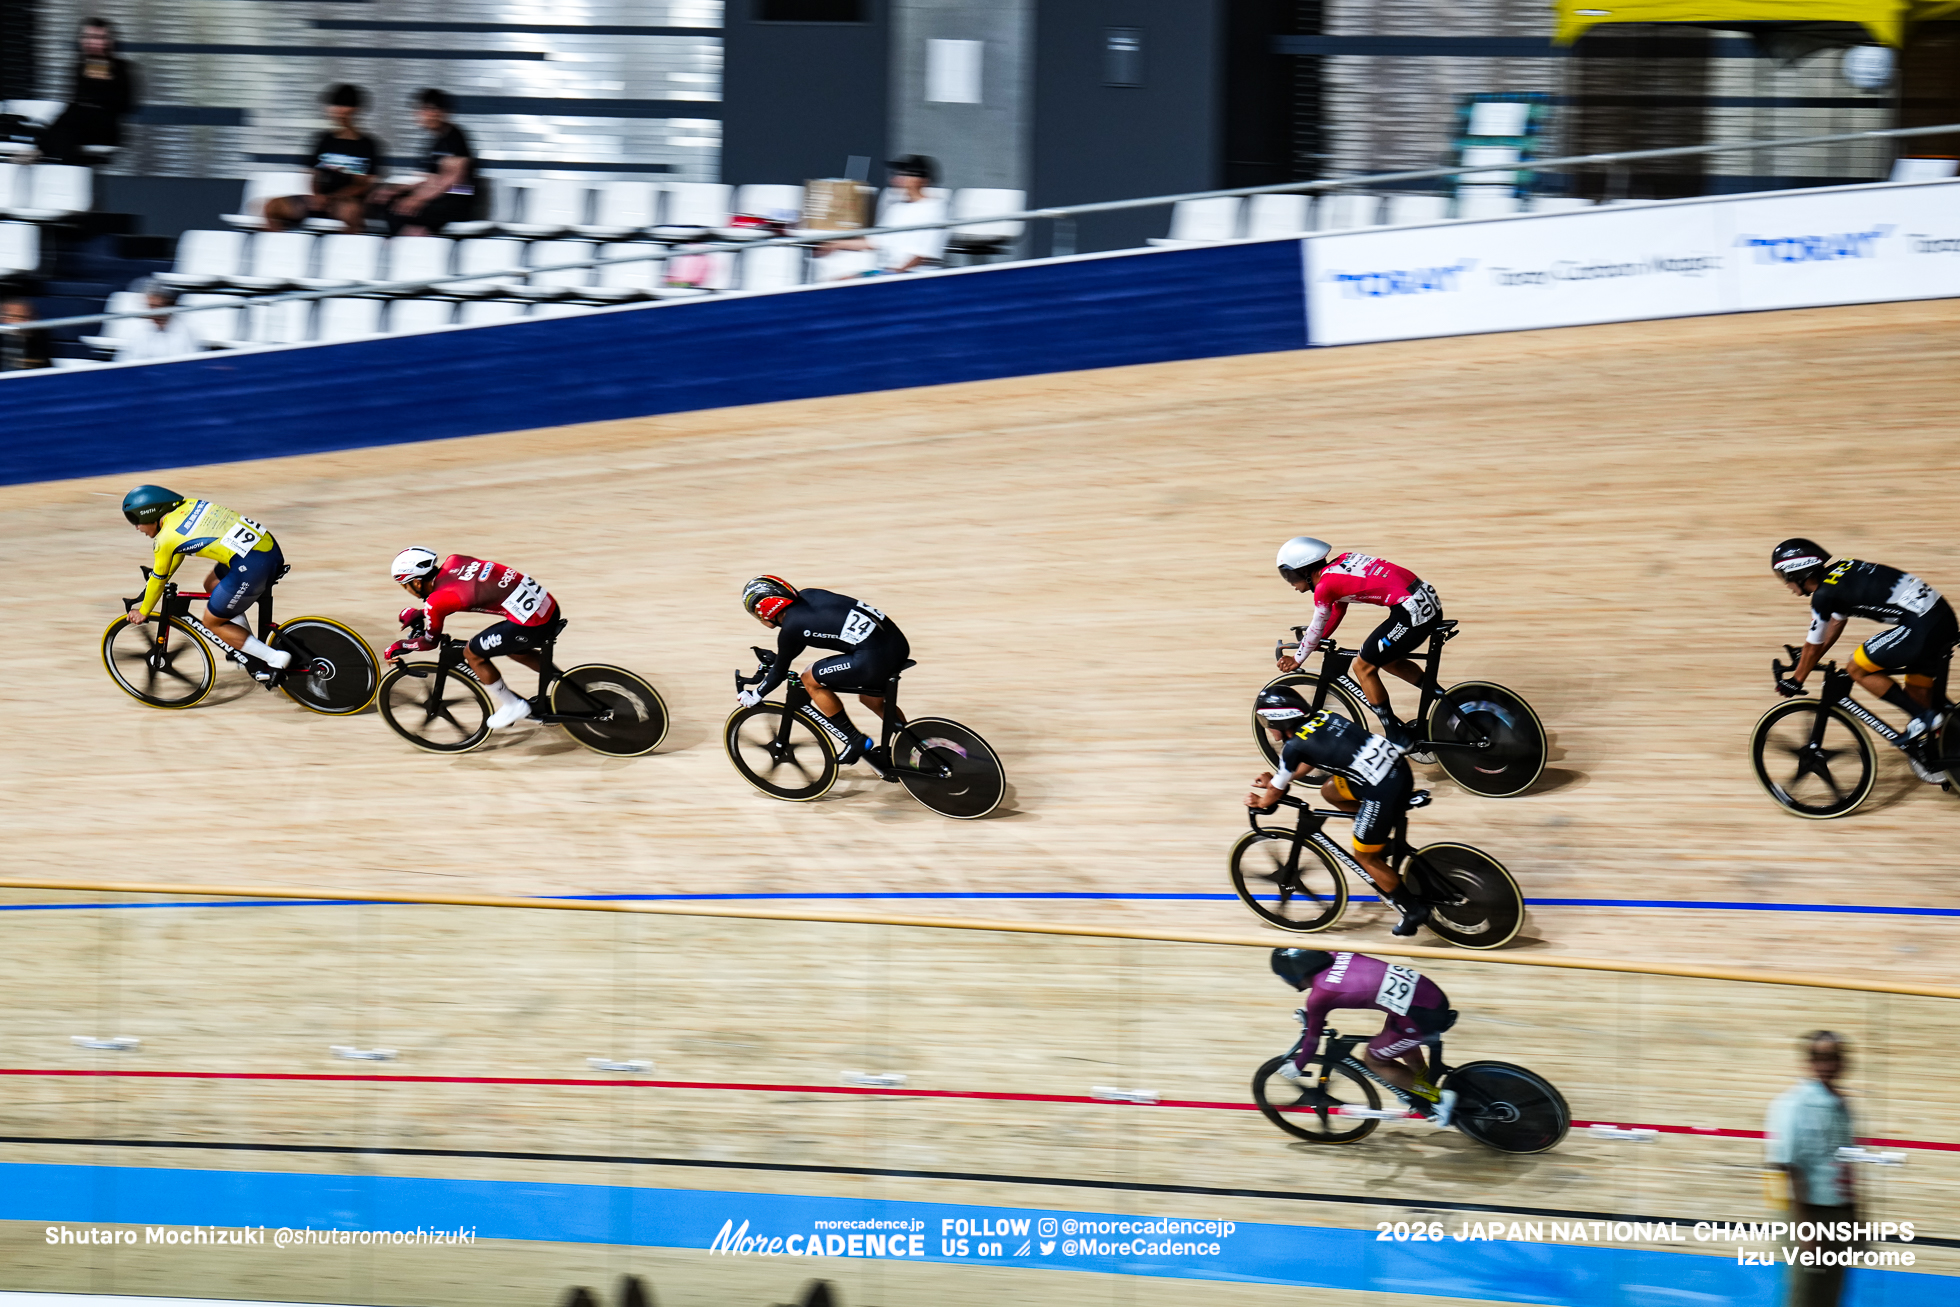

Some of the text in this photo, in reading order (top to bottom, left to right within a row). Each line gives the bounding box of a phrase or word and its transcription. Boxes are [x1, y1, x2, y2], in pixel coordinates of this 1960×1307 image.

[234, 527, 256, 544] 19
[458, 561, 482, 581] lotto
[516, 590, 537, 611] 16
[766, 599, 784, 616] JAPAN
[1413, 592, 1432, 617] 20
[847, 613, 871, 636] 24
[1386, 622, 1404, 640] ANEST
[181, 615, 249, 665] ARGON 18
[480, 633, 502, 650] lotto
[818, 662, 851, 676] CASTELLI
[1364, 748, 1387, 770] 21
[1310, 832, 1375, 885] BRIDGESTONE
[1384, 977, 1410, 1000] 29
